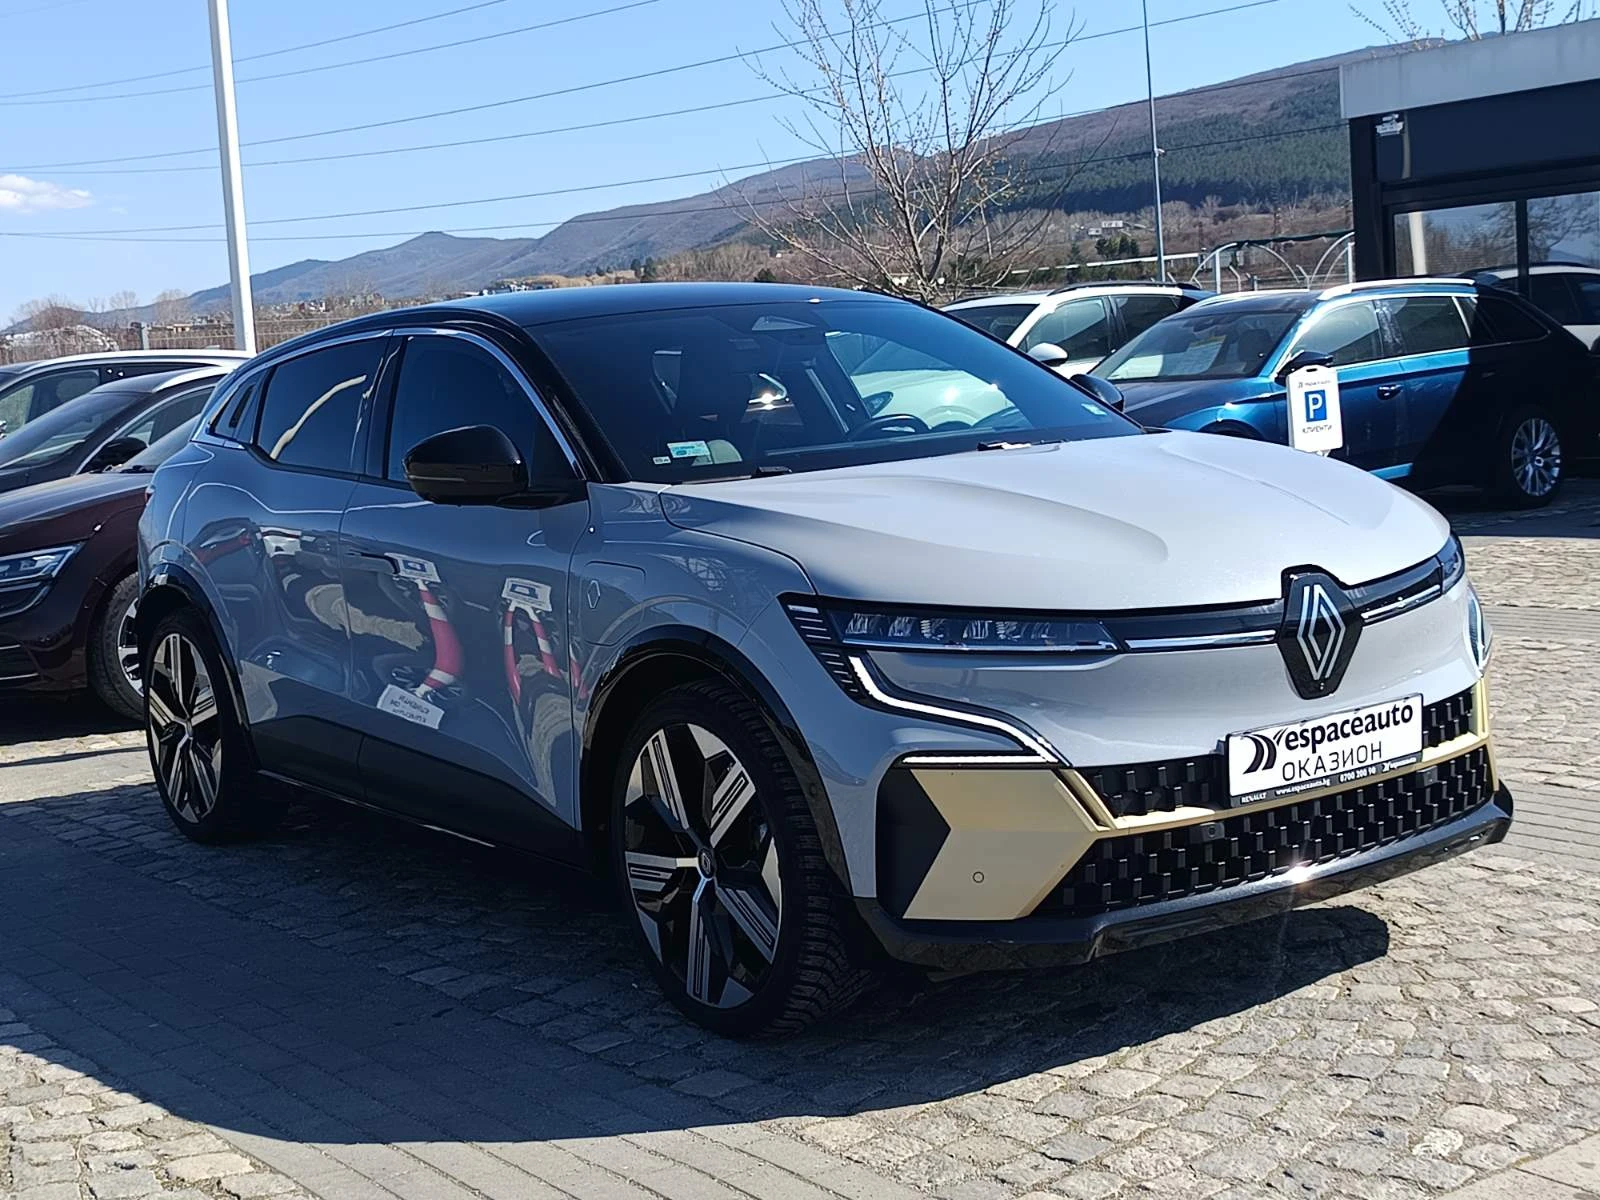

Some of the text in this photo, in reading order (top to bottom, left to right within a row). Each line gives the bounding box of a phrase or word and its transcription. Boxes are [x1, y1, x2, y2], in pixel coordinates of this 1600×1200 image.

[1308, 394, 1323, 419] P
[1284, 703, 1414, 753] espaceauto
[1282, 741, 1383, 782] ОКАЗИОН
[1241, 792, 1267, 804] RENAULT
